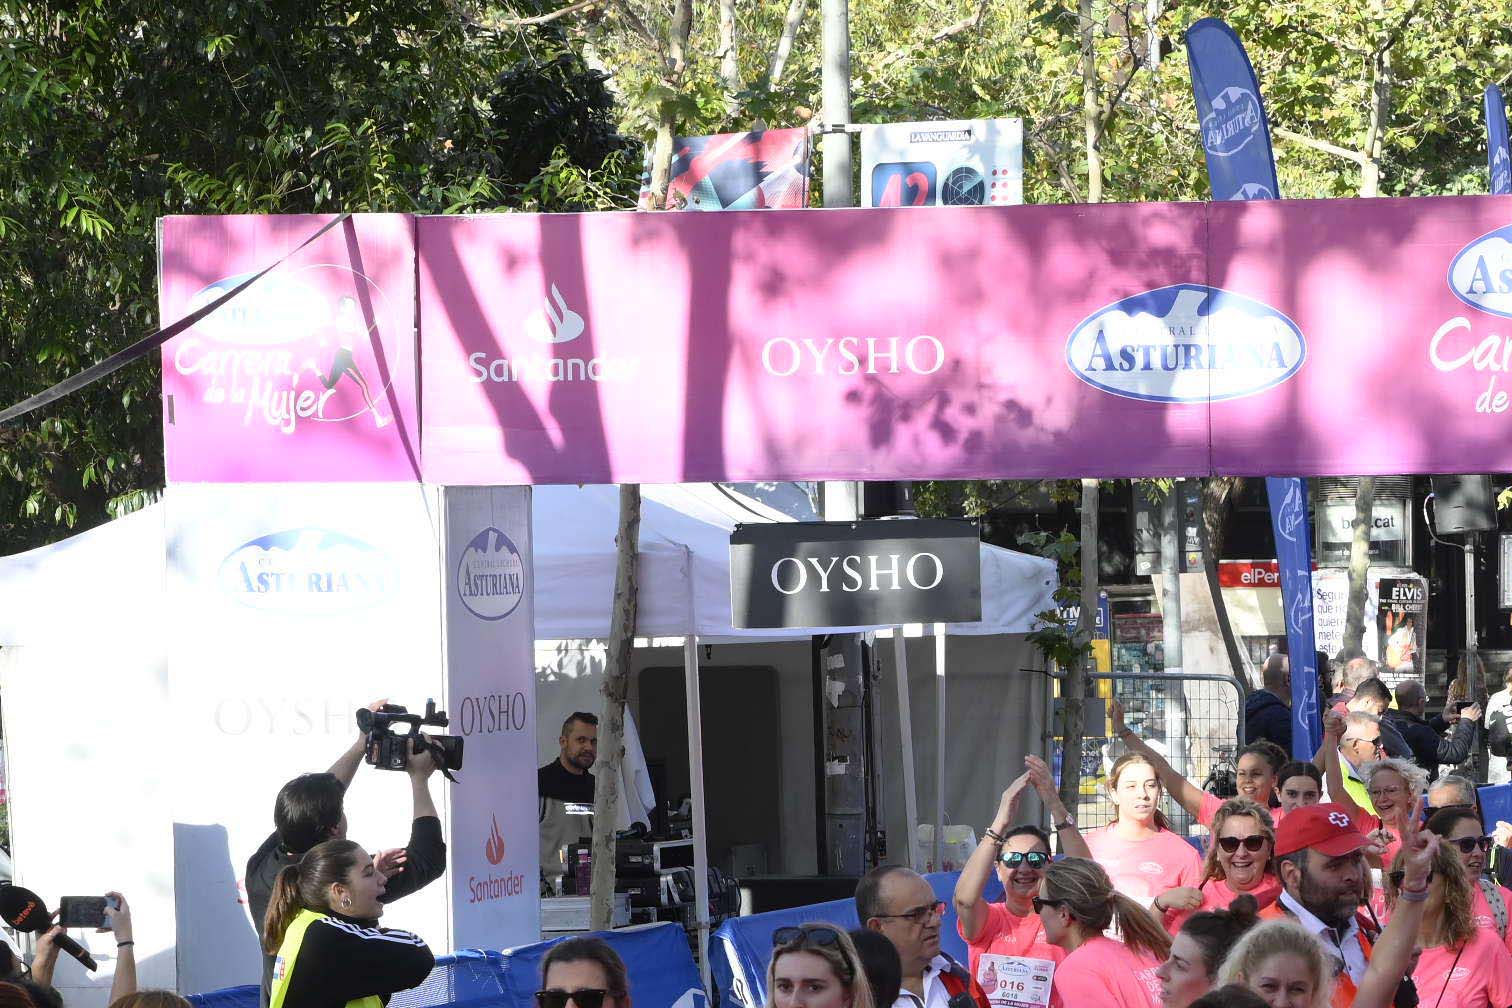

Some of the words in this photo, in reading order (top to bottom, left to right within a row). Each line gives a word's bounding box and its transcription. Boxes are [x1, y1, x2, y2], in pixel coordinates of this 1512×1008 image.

[175, 337, 293, 376] Carrera
[761, 335, 945, 376] OYSHO
[243, 375, 338, 436] Mujer
[1475, 376, 1510, 414] de
[463, 561, 520, 597] ASTURIANA
[771, 553, 944, 595] OYSHO
[1392, 588, 1422, 600] ELVIS
[214, 698, 354, 737] OYSH
[460, 692, 526, 737] OYSHO
[469, 871, 524, 904] Santander
[1000, 980, 1025, 991] 016
